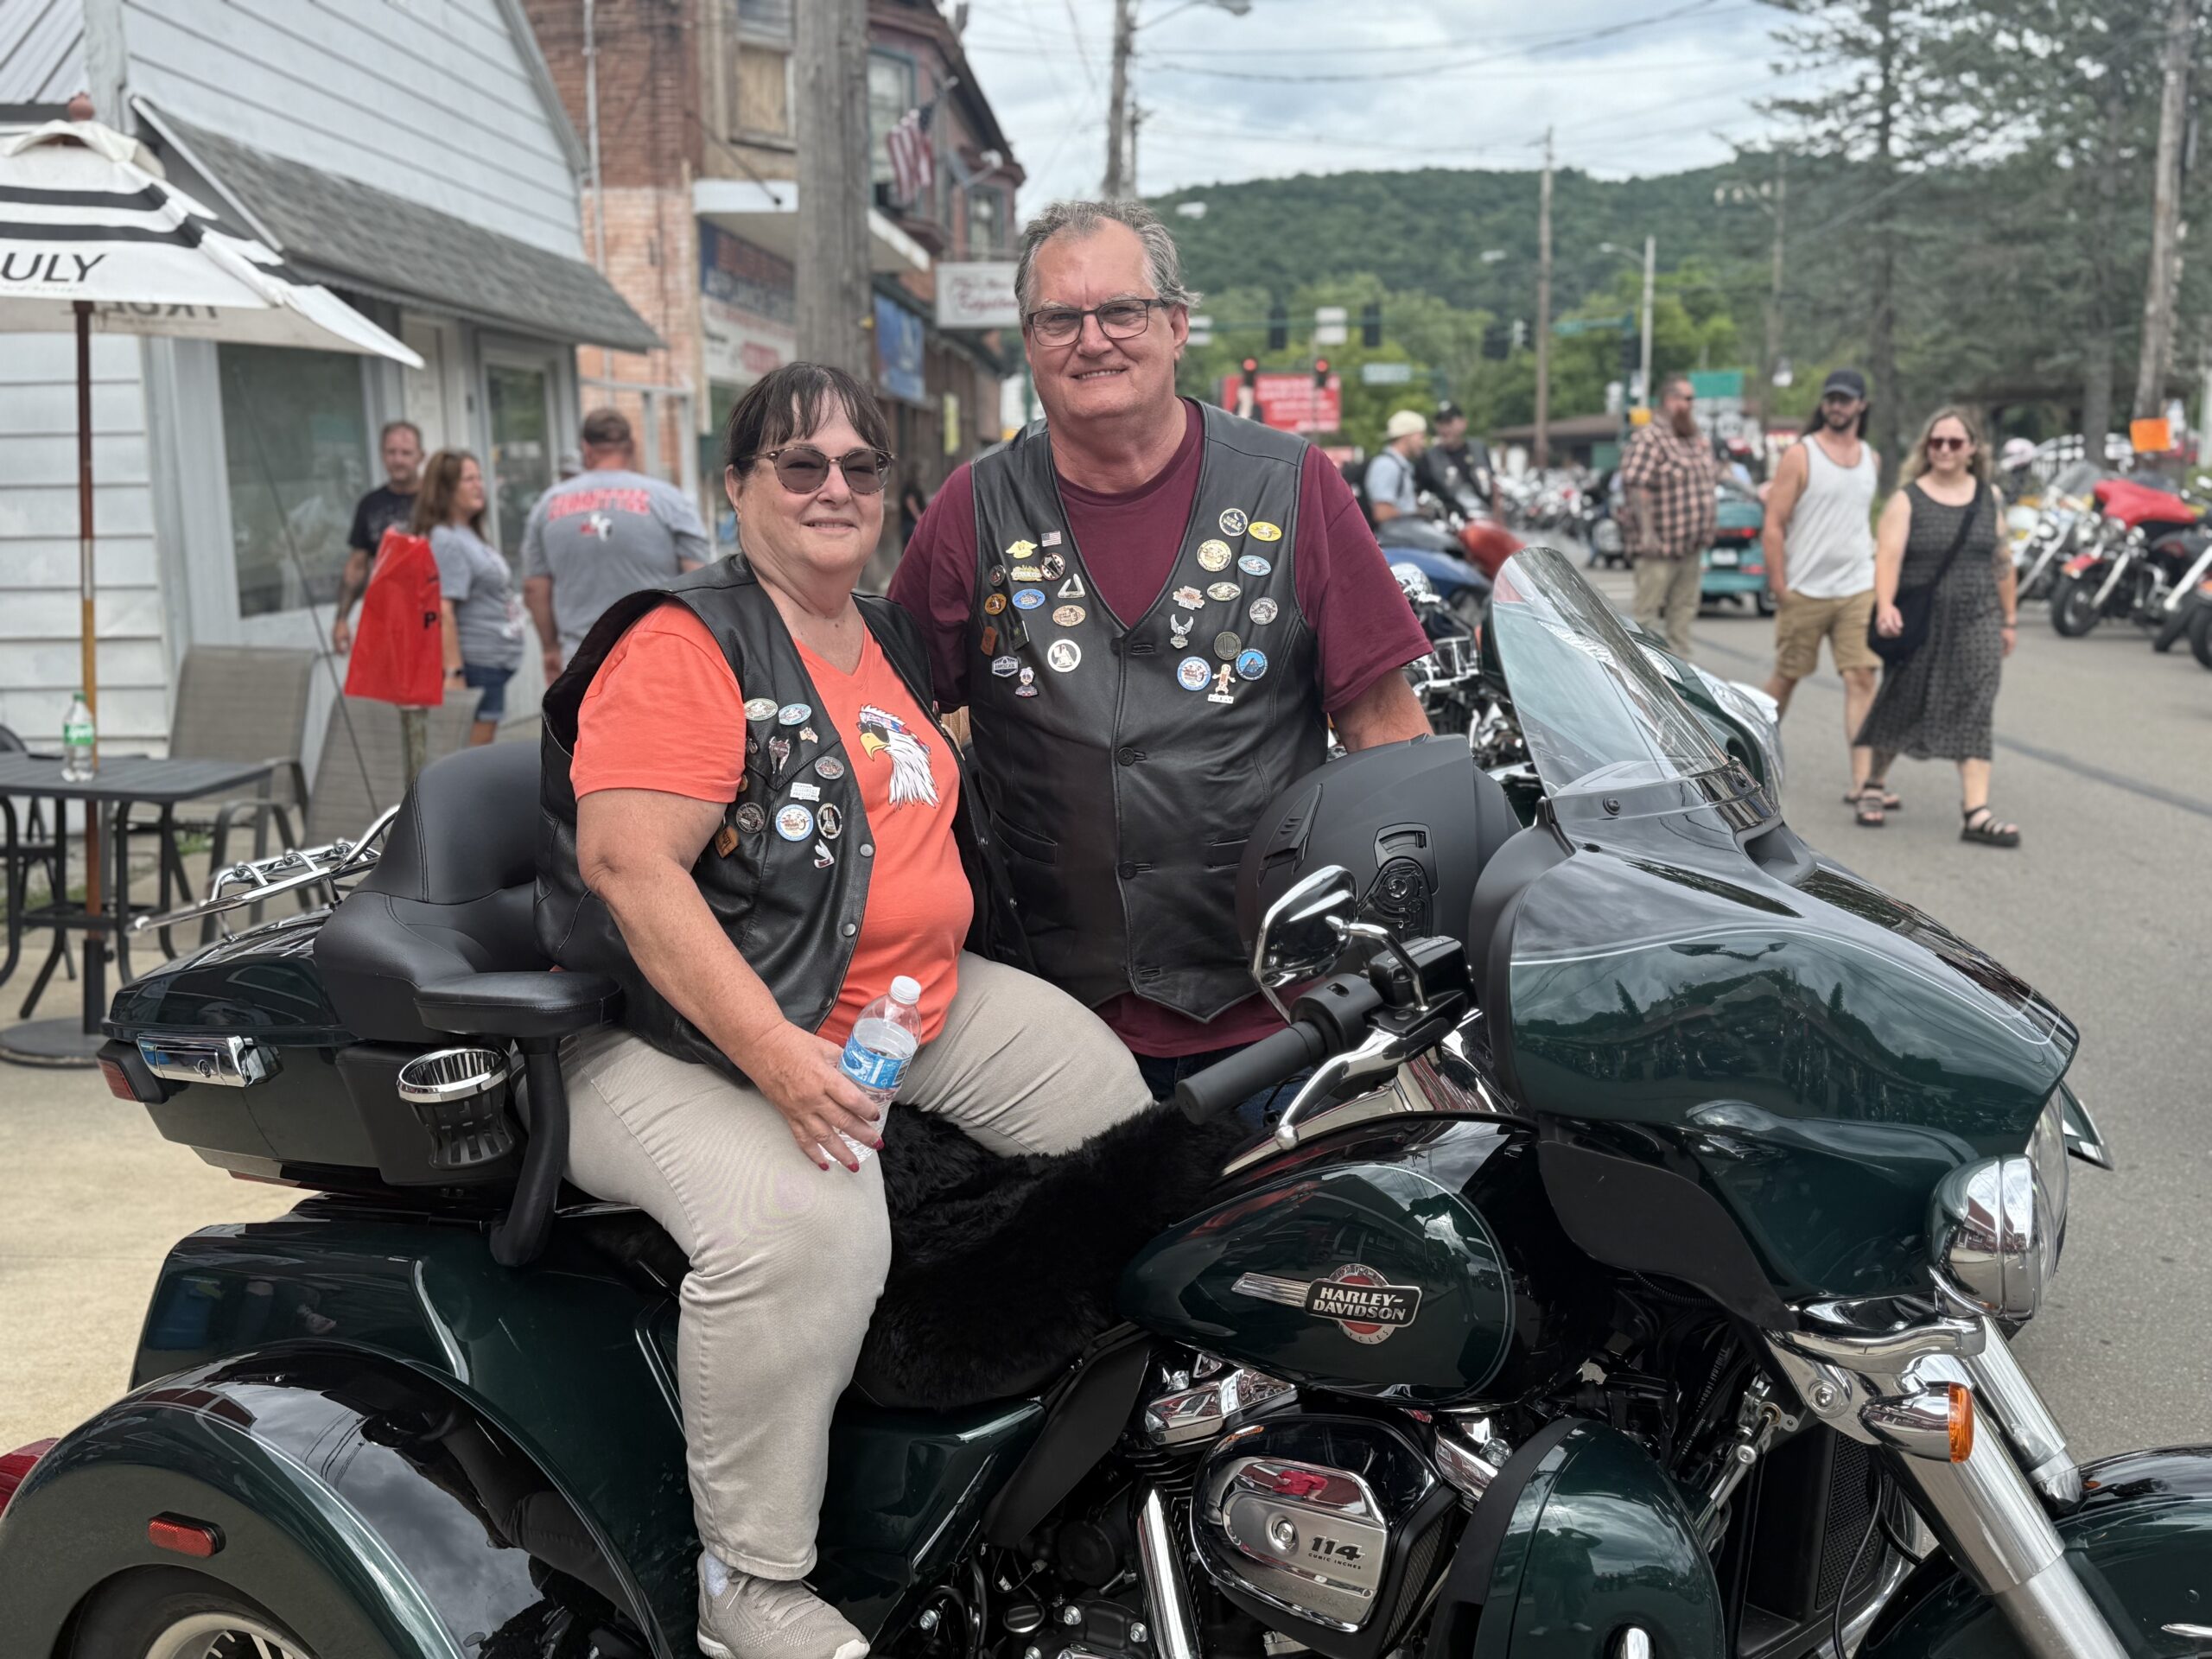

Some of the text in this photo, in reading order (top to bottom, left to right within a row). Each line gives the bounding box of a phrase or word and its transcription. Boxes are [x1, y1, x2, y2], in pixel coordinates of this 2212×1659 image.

[0, 253, 106, 282] ULY
[1319, 1287, 1404, 1306] HARLEY-
[1313, 1299, 1406, 1320] DAVIDSON
[1339, 1324, 1389, 1343] CYCLES
[1311, 1535, 1363, 1561] 114
[1308, 1553, 1362, 1570] CUBIC INCHES
